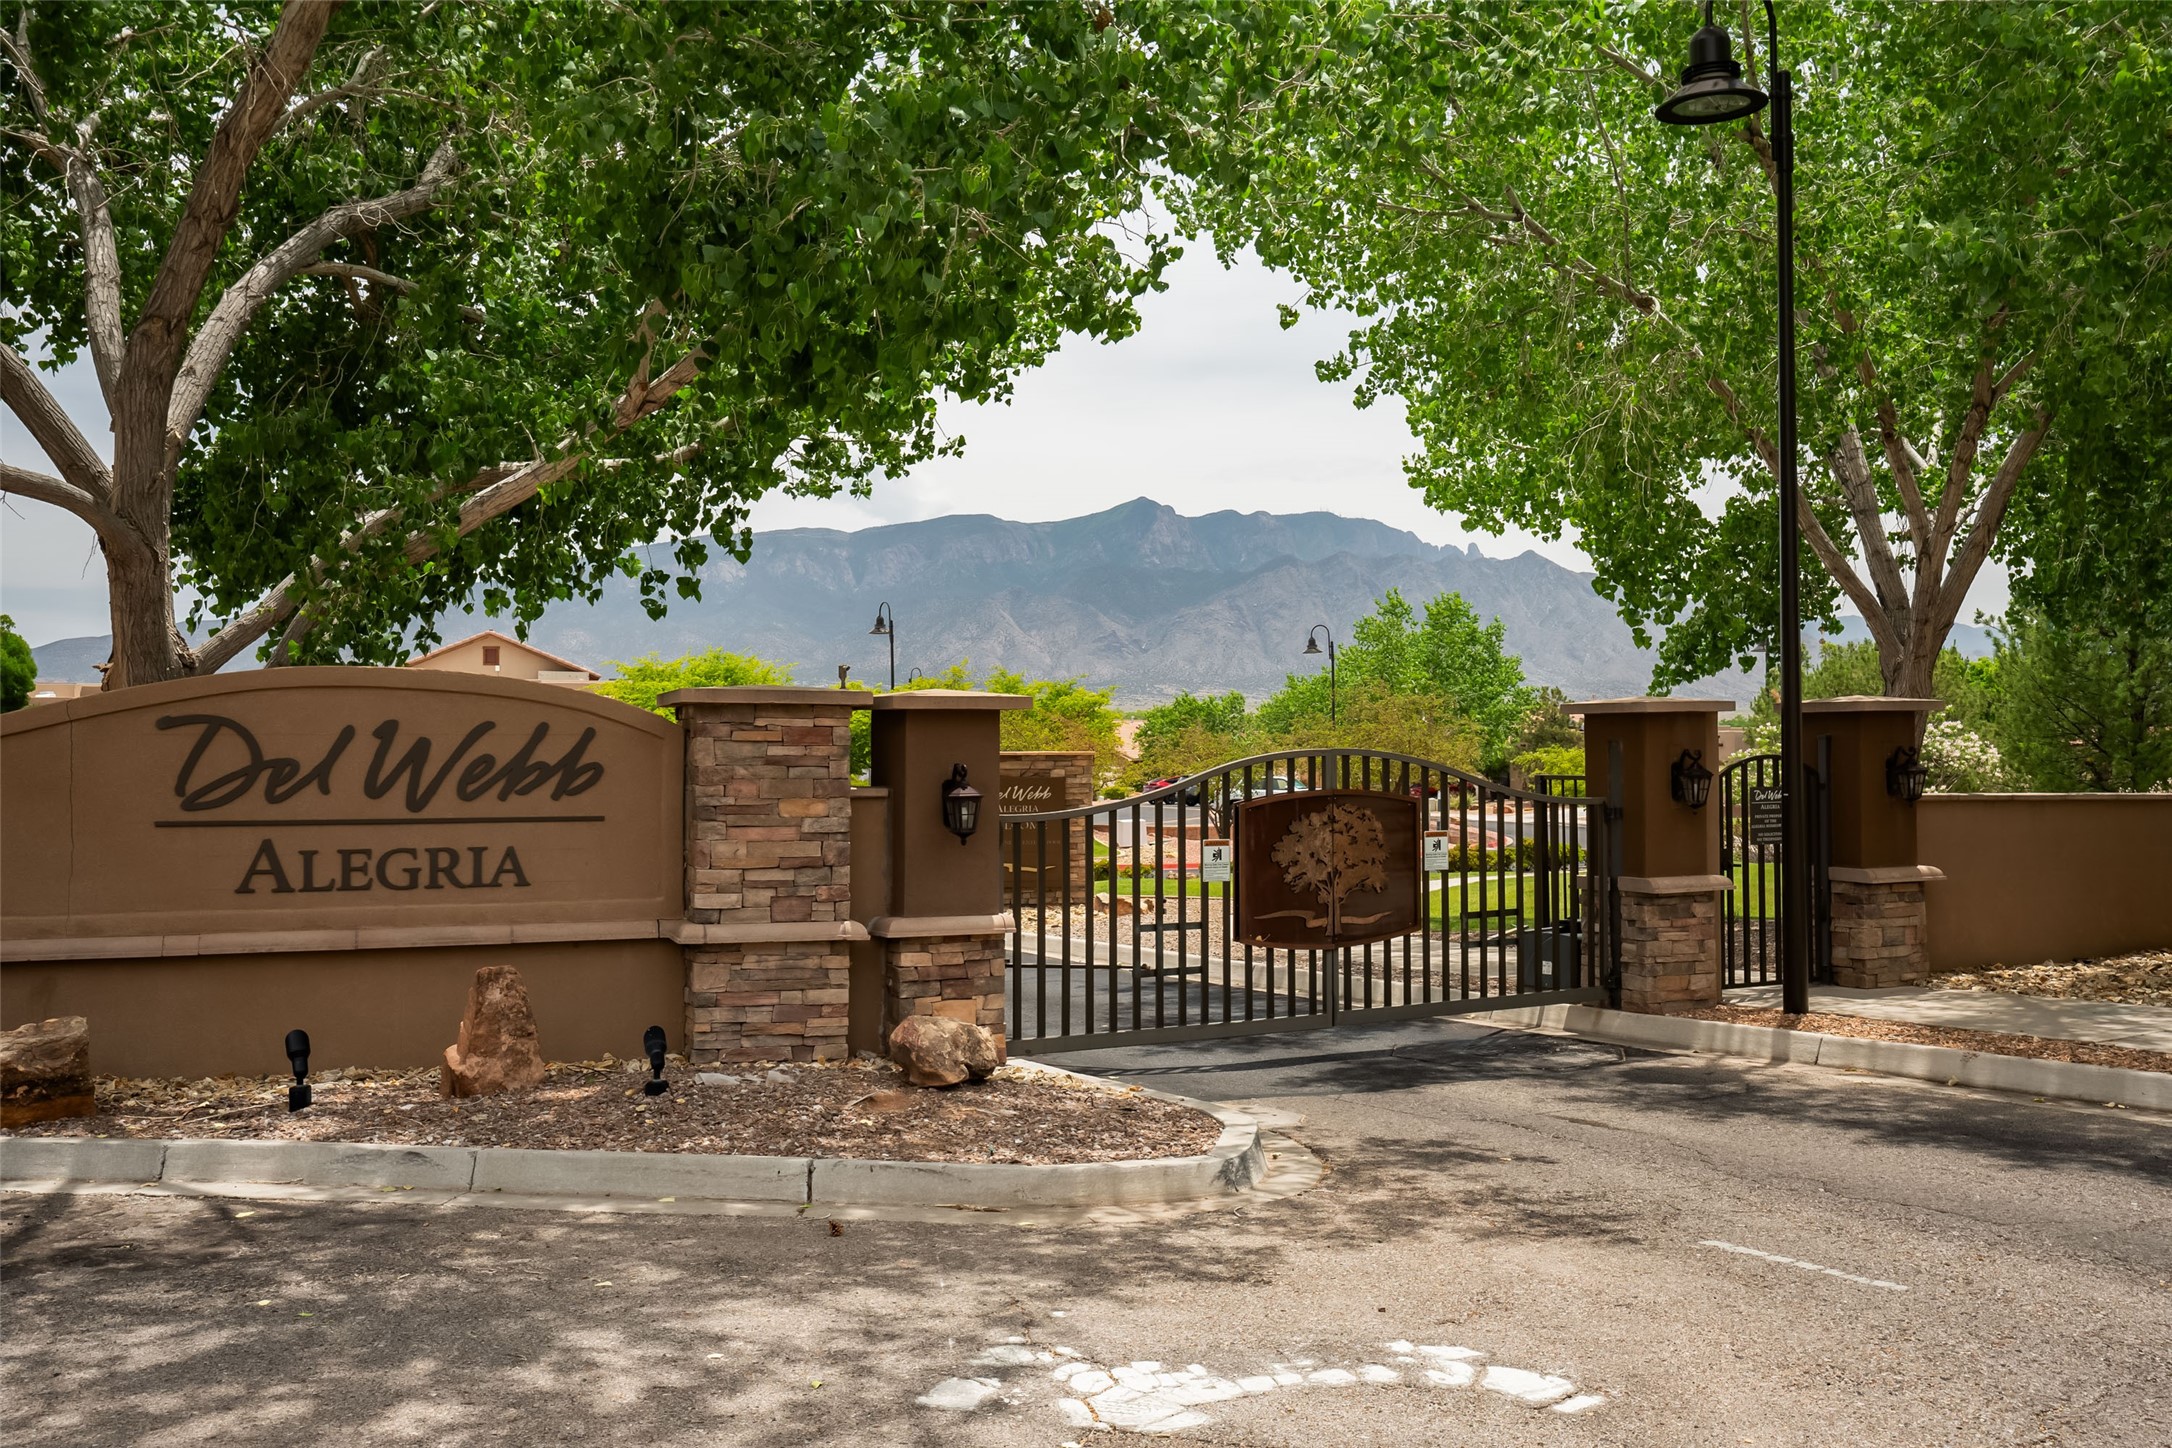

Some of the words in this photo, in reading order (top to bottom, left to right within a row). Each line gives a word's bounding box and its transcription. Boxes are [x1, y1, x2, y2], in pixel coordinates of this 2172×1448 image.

[155, 713, 355, 812] Del
[363, 718, 605, 813] Webb
[999, 786, 1012, 800] el
[1012, 785, 1052, 802] Webb
[1754, 790, 1768, 800] Del
[1768, 790, 1782, 800] Web
[234, 838, 531, 894] ALEGRIA
